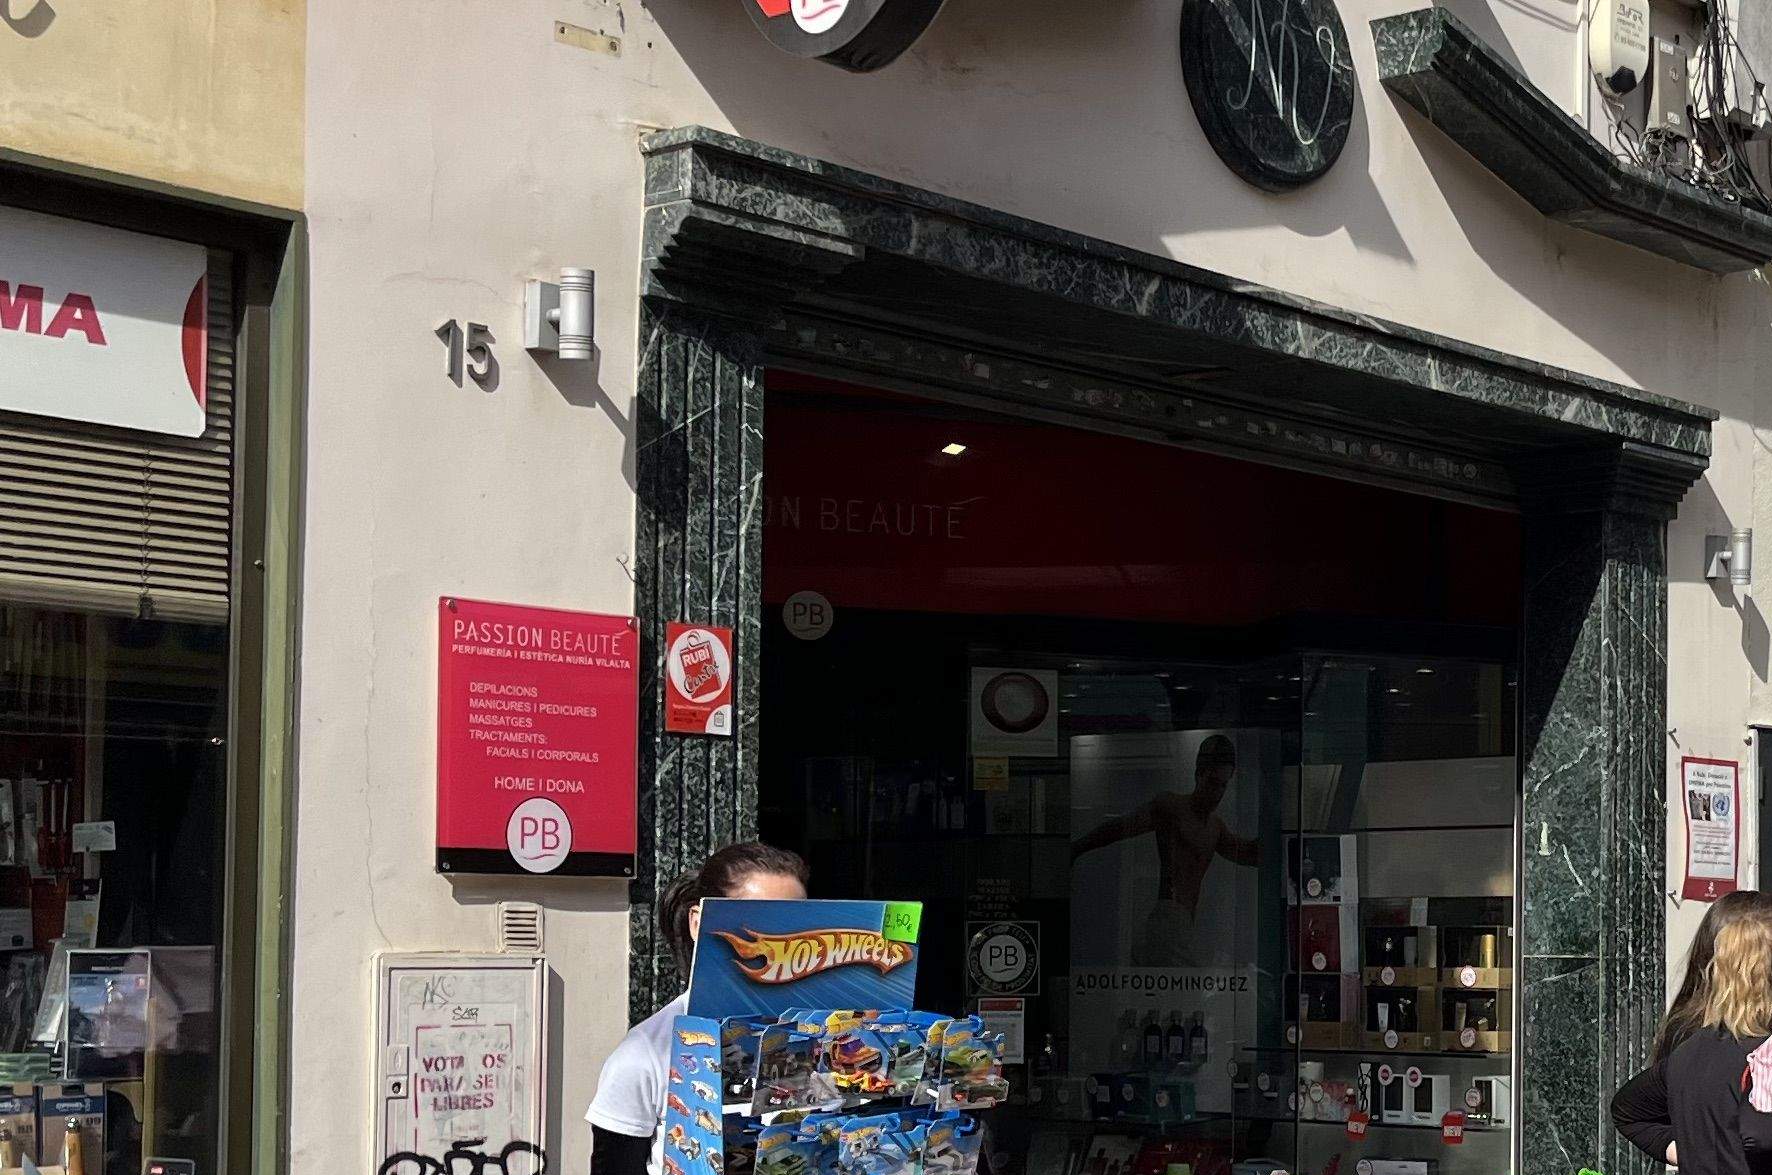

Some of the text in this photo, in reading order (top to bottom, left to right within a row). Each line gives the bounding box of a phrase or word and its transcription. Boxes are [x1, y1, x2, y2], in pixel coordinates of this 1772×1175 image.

[435, 318, 493, 384] 15
[792, 604, 825, 625] PB
[454, 619, 543, 648] PASSION
[596, 657, 631, 669] VILALTA
[469, 682, 538, 698] DEPILACIONS
[469, 698, 531, 713] MANICURES
[539, 704, 598, 718] PEDICURES
[469, 714, 533, 728] MASSATGES
[486, 746, 529, 759] FACIALS
[537, 750, 599, 763] CORPORALS
[494, 776, 535, 791] HOME
[546, 778, 585, 793] DONA
[520, 817, 560, 850] PB
[989, 946, 1019, 967] PB
